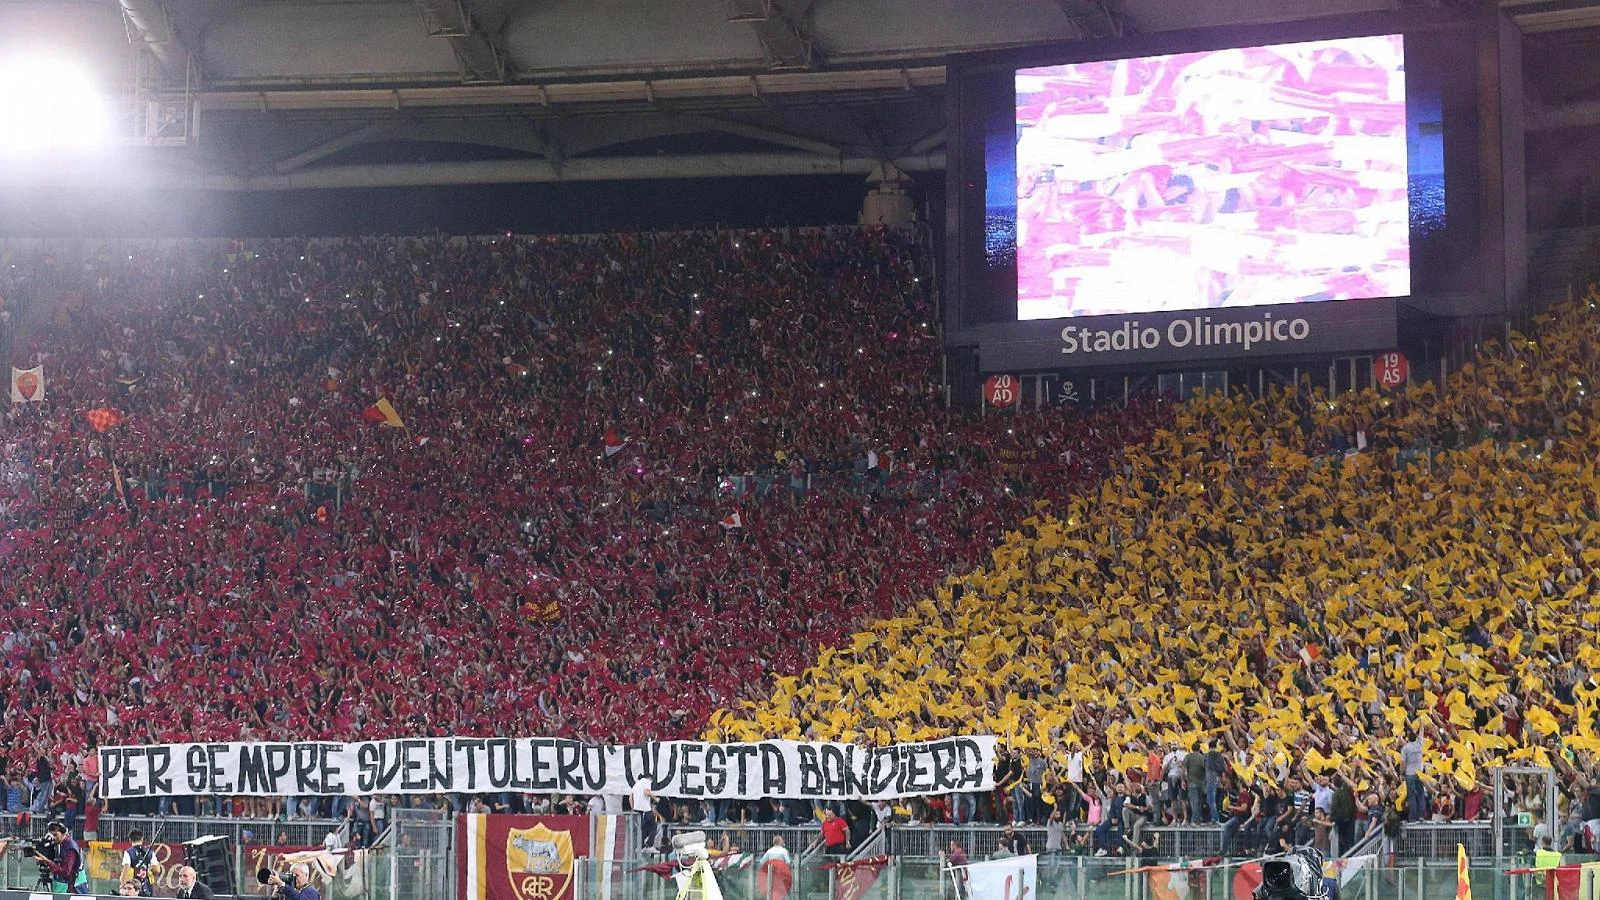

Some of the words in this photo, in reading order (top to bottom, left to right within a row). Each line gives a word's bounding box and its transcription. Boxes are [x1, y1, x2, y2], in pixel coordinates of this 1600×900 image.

[1061, 320, 1161, 354] Stadio
[1167, 312, 1310, 351] Olimpico
[1383, 353, 1399, 368] 19
[994, 374, 1011, 388] 20
[1383, 369, 1400, 383] AS
[992, 389, 1013, 403] AD
[101, 747, 172, 796] PER
[186, 743, 344, 793] SEMPRE
[797, 738, 984, 795] BANDIERA
